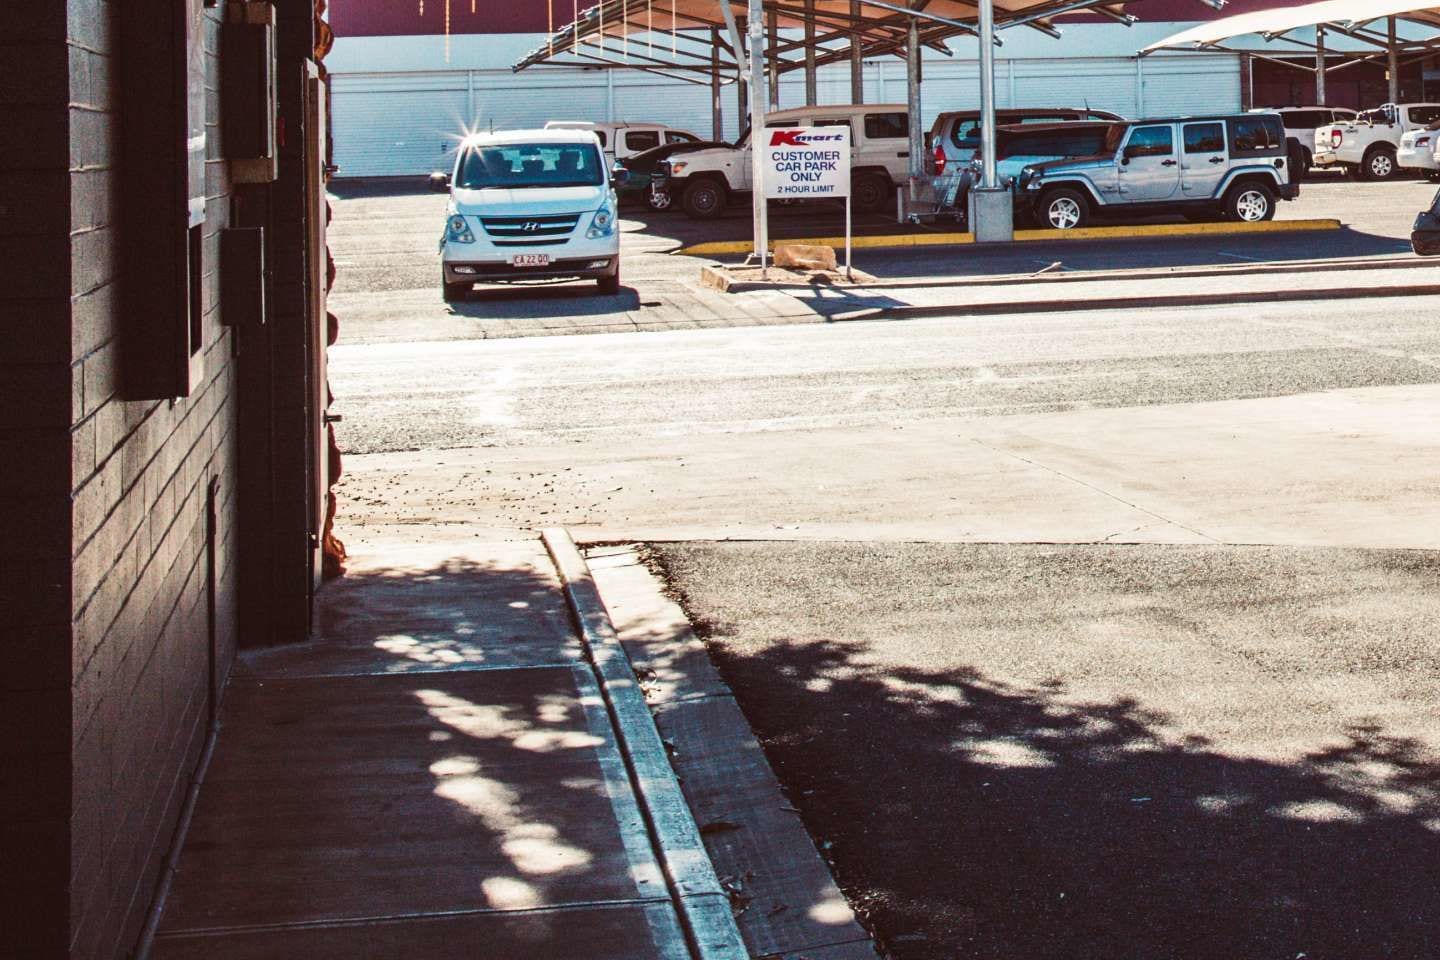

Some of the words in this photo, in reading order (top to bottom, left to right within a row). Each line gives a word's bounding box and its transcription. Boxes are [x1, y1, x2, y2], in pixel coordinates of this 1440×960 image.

[769, 131, 844, 147] Kmart
[772, 150, 840, 161] CUSTOMER
[775, 162, 801, 172] CAR
[804, 161, 837, 171] PARK
[790, 172, 822, 182] ONLY
[777, 185, 783, 193] 2
[784, 185, 810, 193] HOUR
[812, 184, 835, 193] LIMIT
